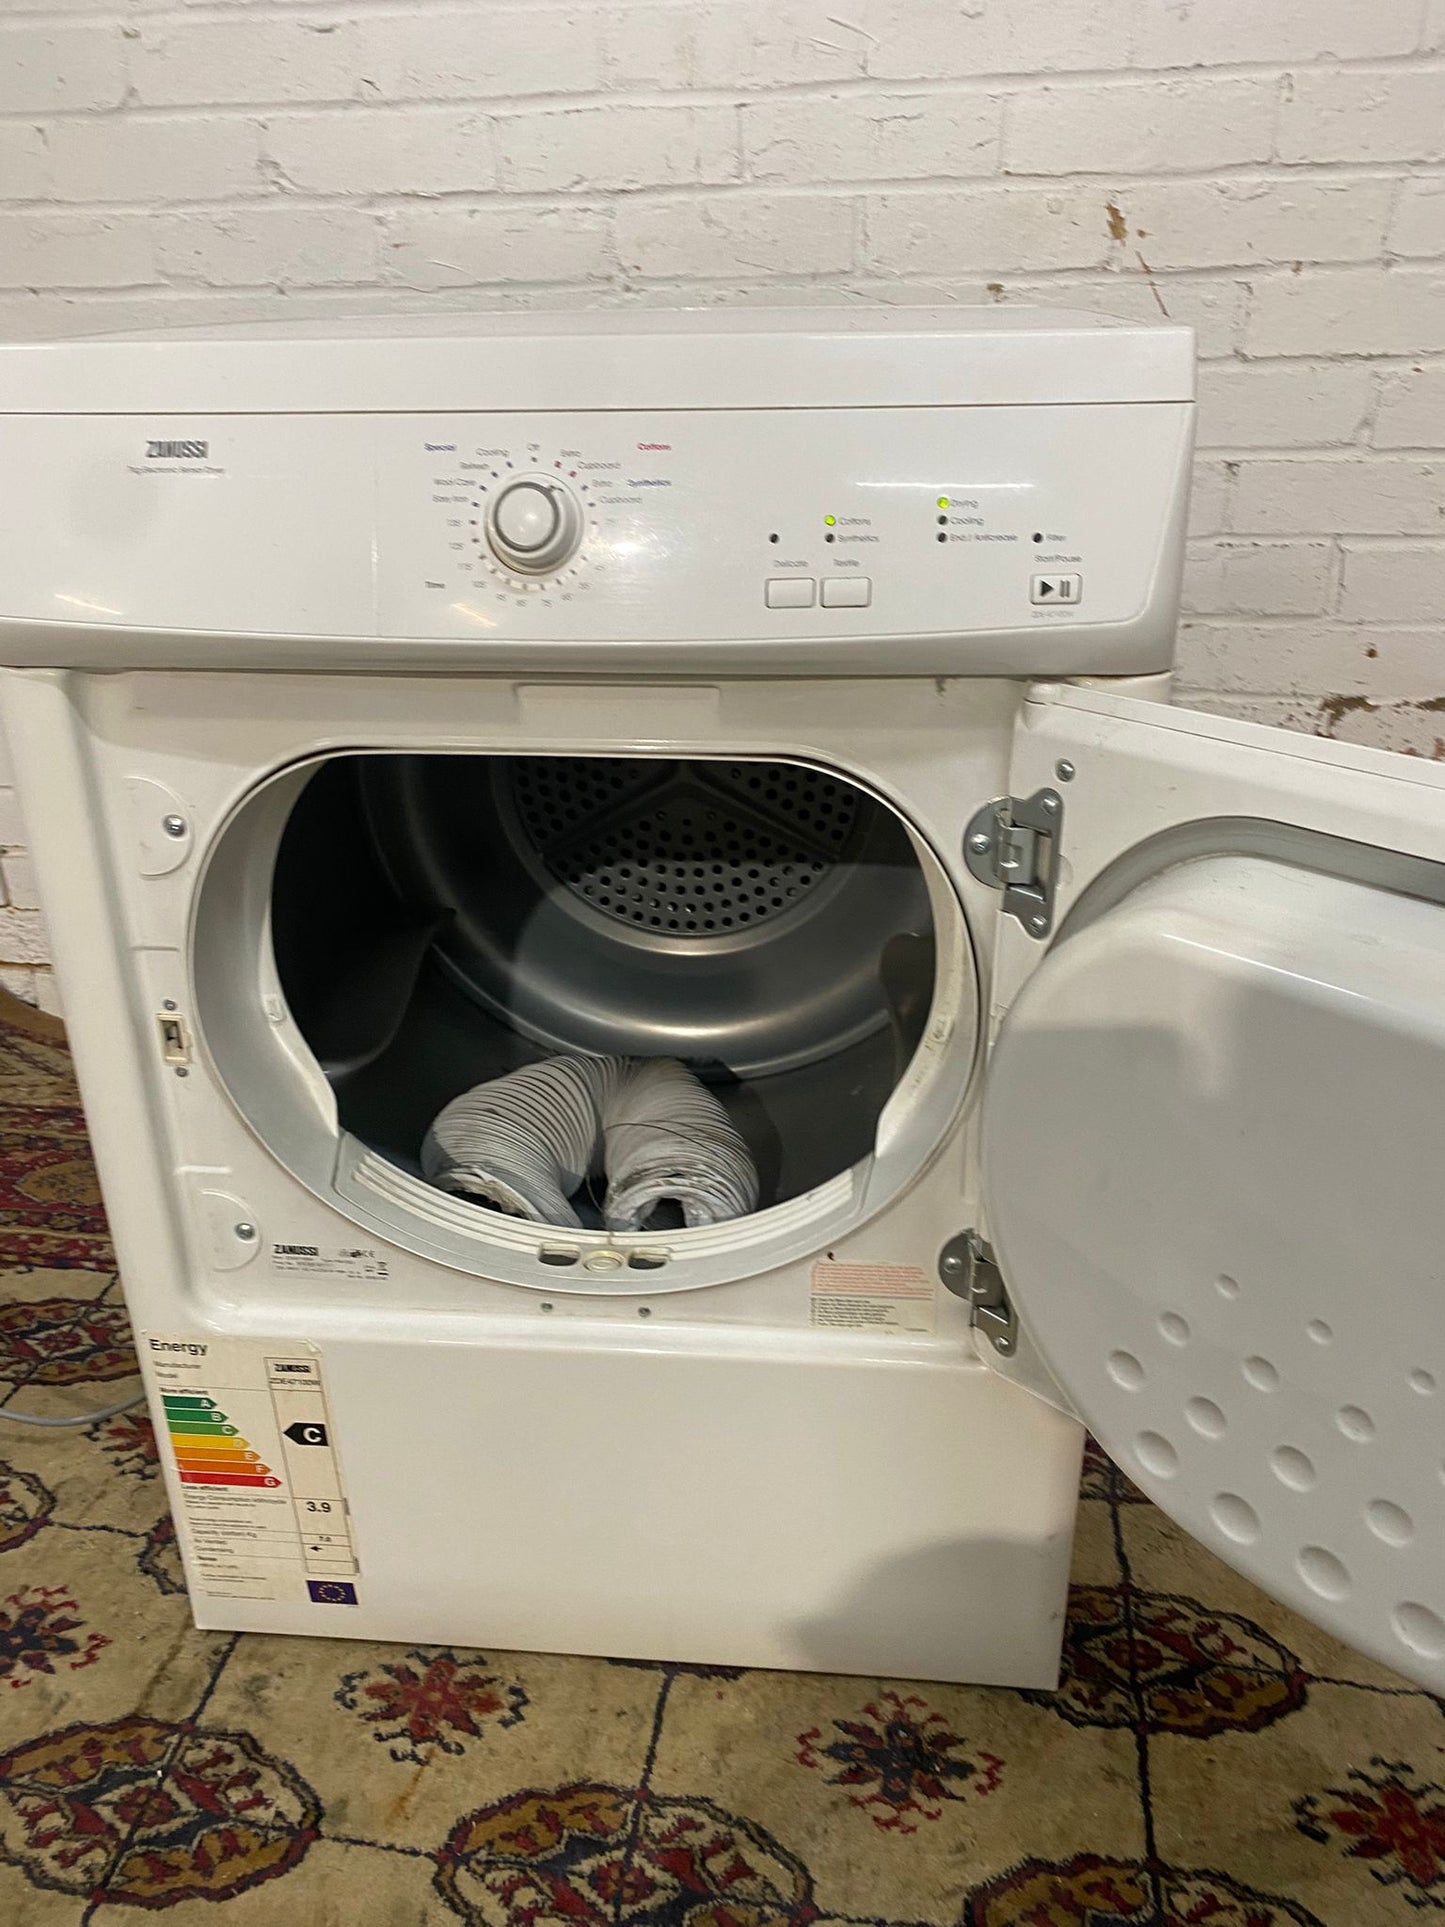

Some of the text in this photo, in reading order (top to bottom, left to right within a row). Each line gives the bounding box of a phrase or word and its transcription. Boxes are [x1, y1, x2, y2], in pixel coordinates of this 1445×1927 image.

[145, 440, 208, 458] ZANUSSI
[475, 448, 510, 458] Cooling
[950, 516, 985, 526] Cooling
[273, 1244, 319, 1257] ZANUSSI
[149, 1338, 209, 1356] Energy
[274, 1363, 311, 1373] ZANUSSI
[201, 1399, 212, 1408] A
[211, 1412, 223, 1422] B
[222, 1425, 233, 1434] C
[302, 1427, 323, 1443] C
[245, 1451, 255, 1460] E
[255, 1464, 265, 1473] F
[264, 1478, 276, 1487] G
[306, 1501, 332, 1513] 3.9
